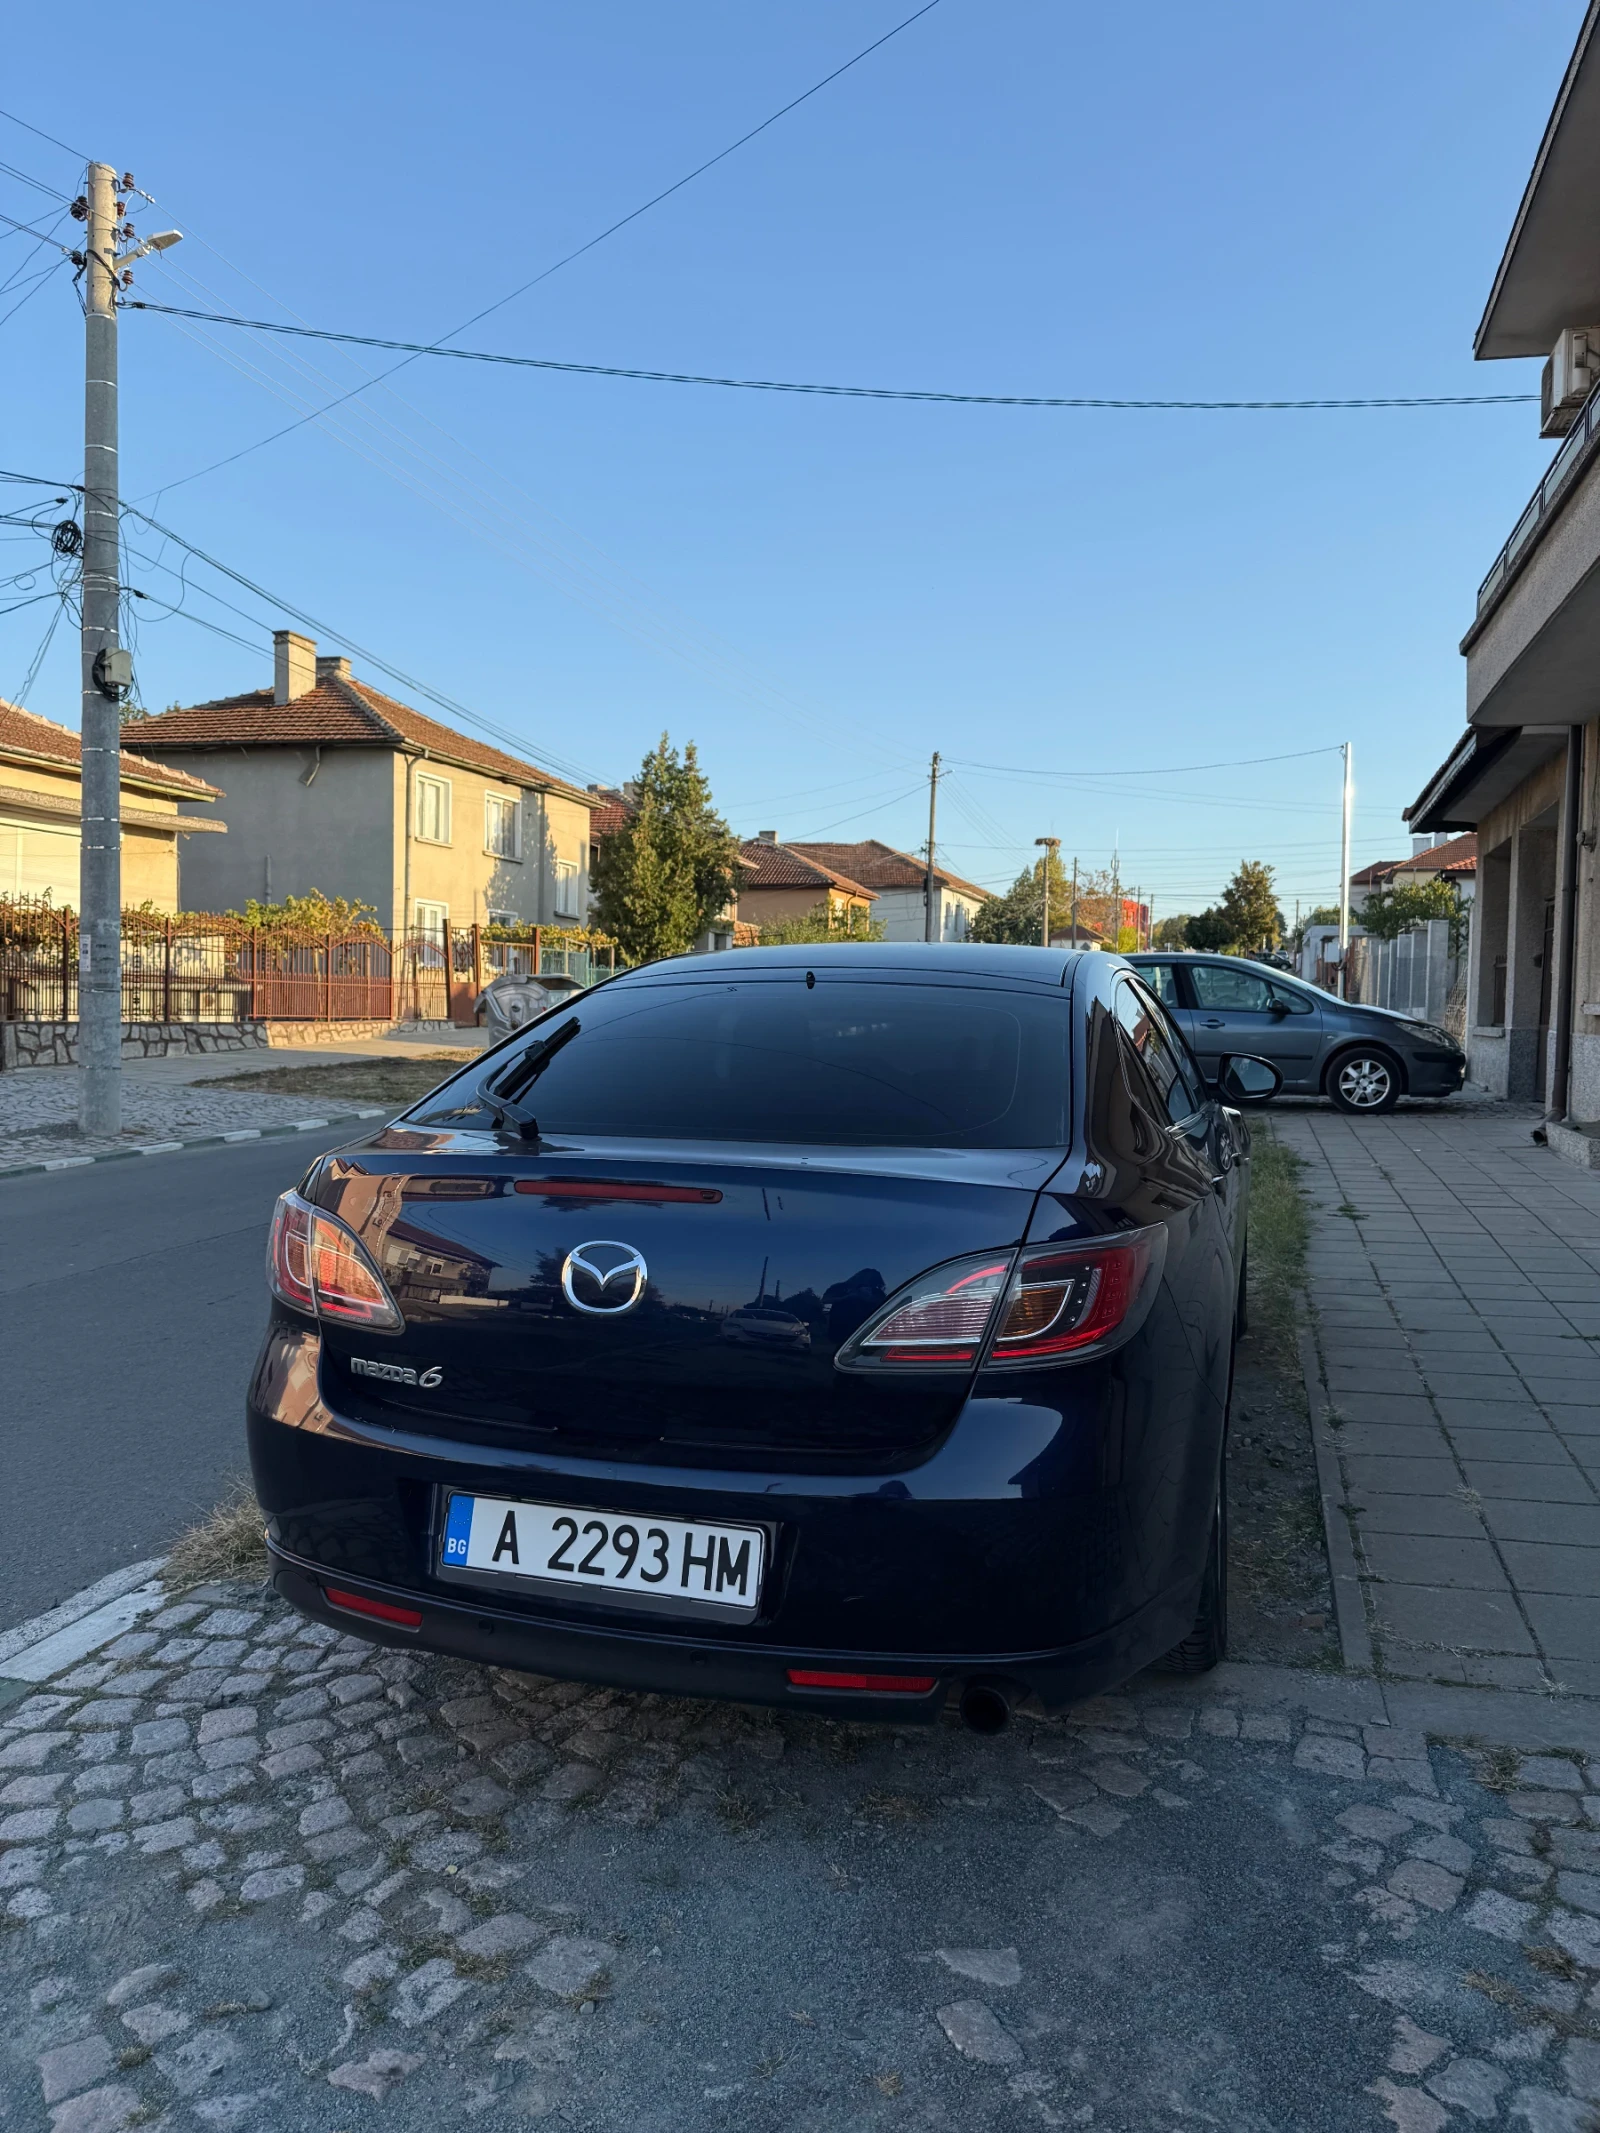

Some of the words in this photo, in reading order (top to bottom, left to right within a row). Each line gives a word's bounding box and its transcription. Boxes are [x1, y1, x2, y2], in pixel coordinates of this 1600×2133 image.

[447, 1537, 467, 1555] BG
[492, 1510, 520, 1565] A
[547, 1516, 669, 1583] 2293
[680, 1532, 751, 1597] HM
